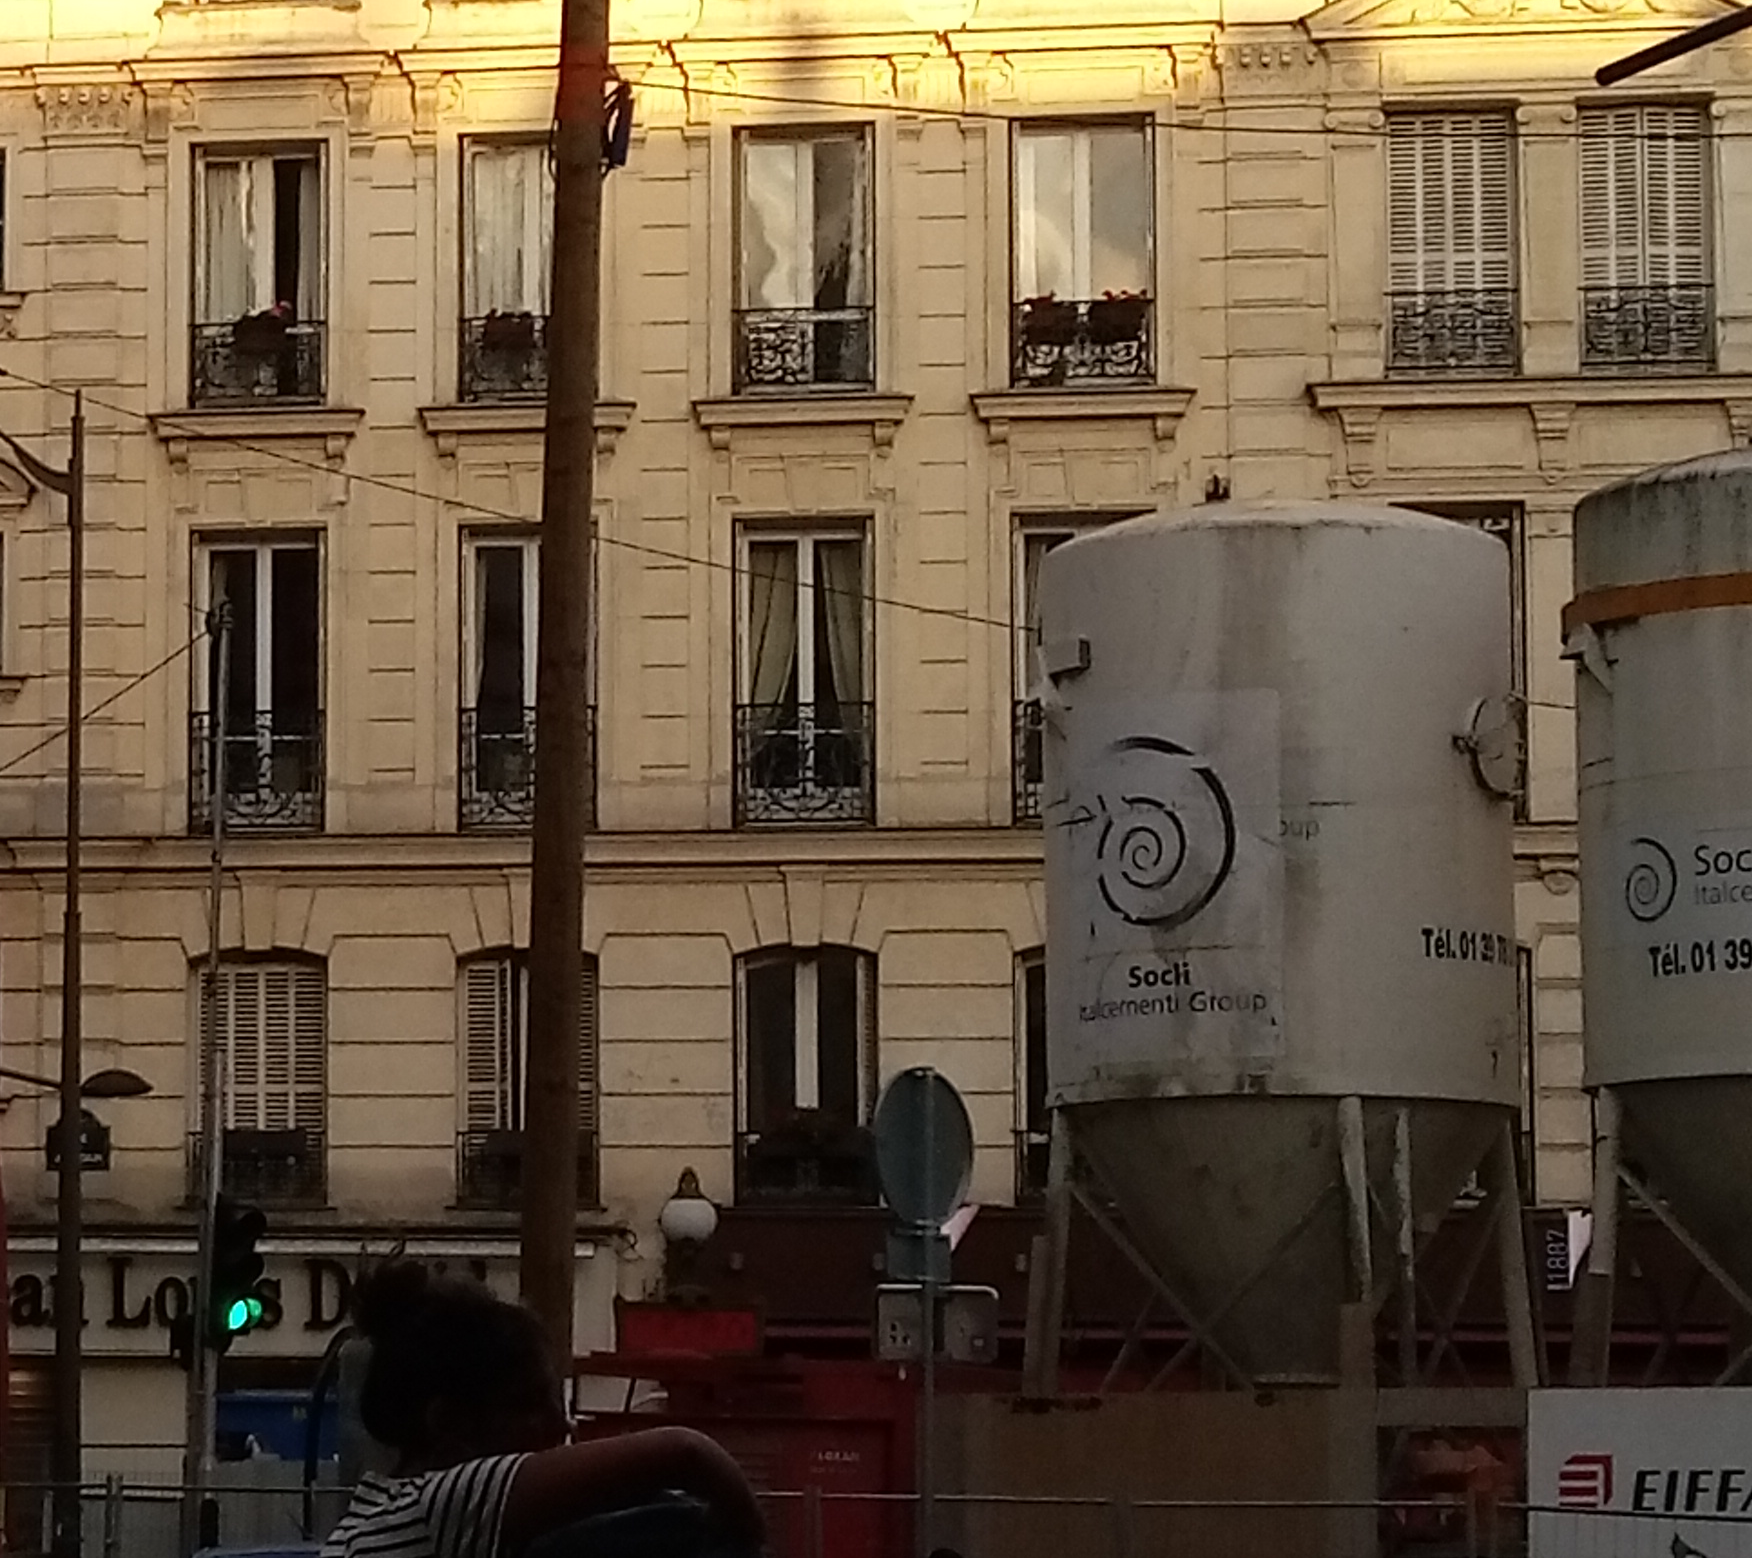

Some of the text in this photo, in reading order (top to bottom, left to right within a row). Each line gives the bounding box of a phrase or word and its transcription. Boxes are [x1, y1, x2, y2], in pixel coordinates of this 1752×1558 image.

[1421, 928, 1456, 959] Tél.
[1459, 931, 1476, 961] 01
[1649, 938, 1752, 977] Tél. 01 39
[1129, 962, 1190, 988] Socli
[1189, 992, 1266, 1014] Group
[106, 1256, 282, 1329] Los
